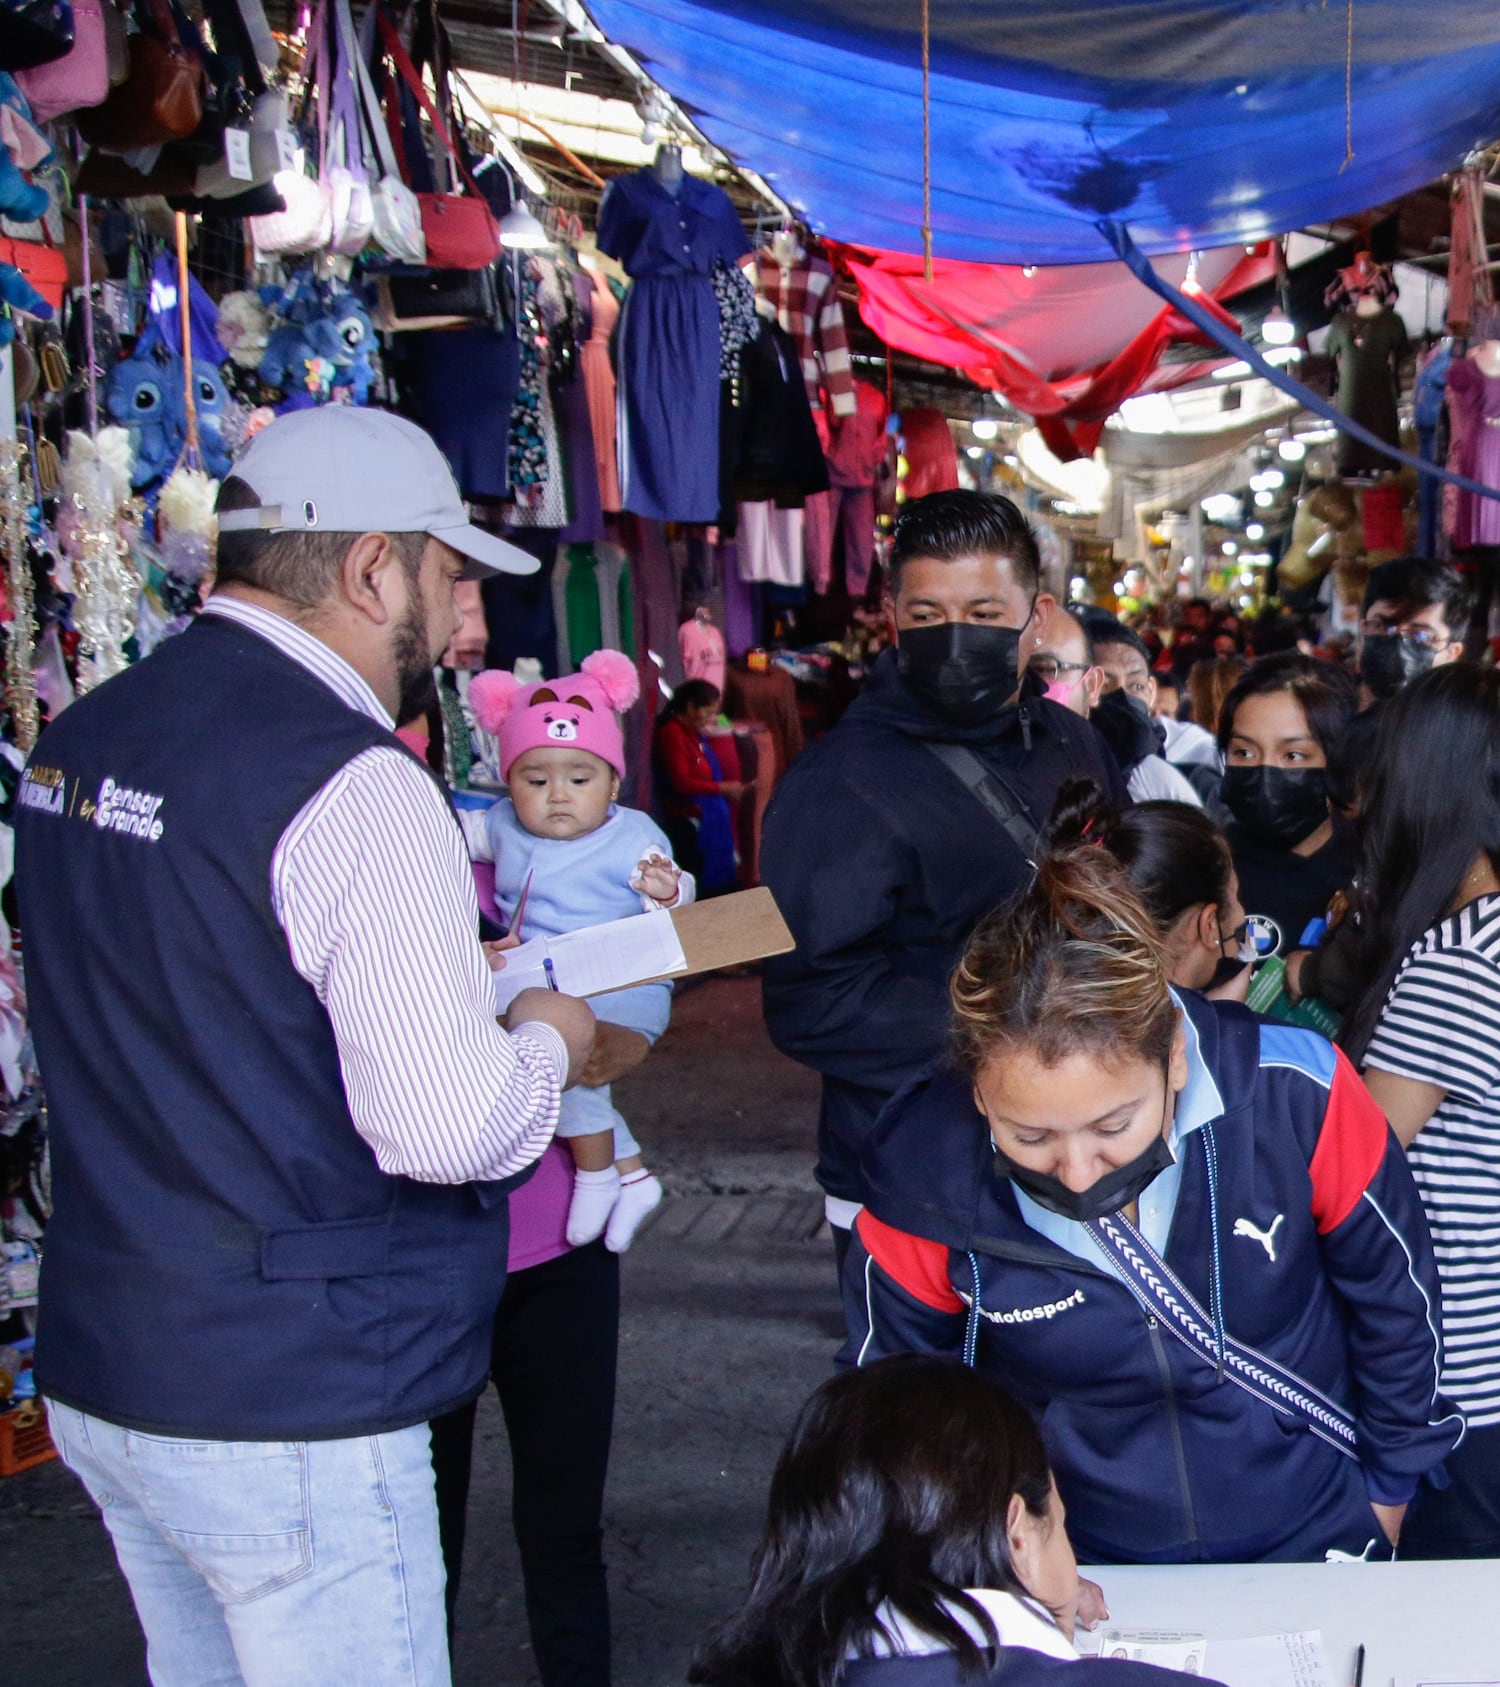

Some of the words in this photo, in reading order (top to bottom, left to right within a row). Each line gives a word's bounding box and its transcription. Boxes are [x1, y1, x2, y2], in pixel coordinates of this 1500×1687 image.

[100, 778, 164, 813] Pensar
[97, 801, 164, 841] Grande
[986, 1289, 1085, 1323] Motosport
